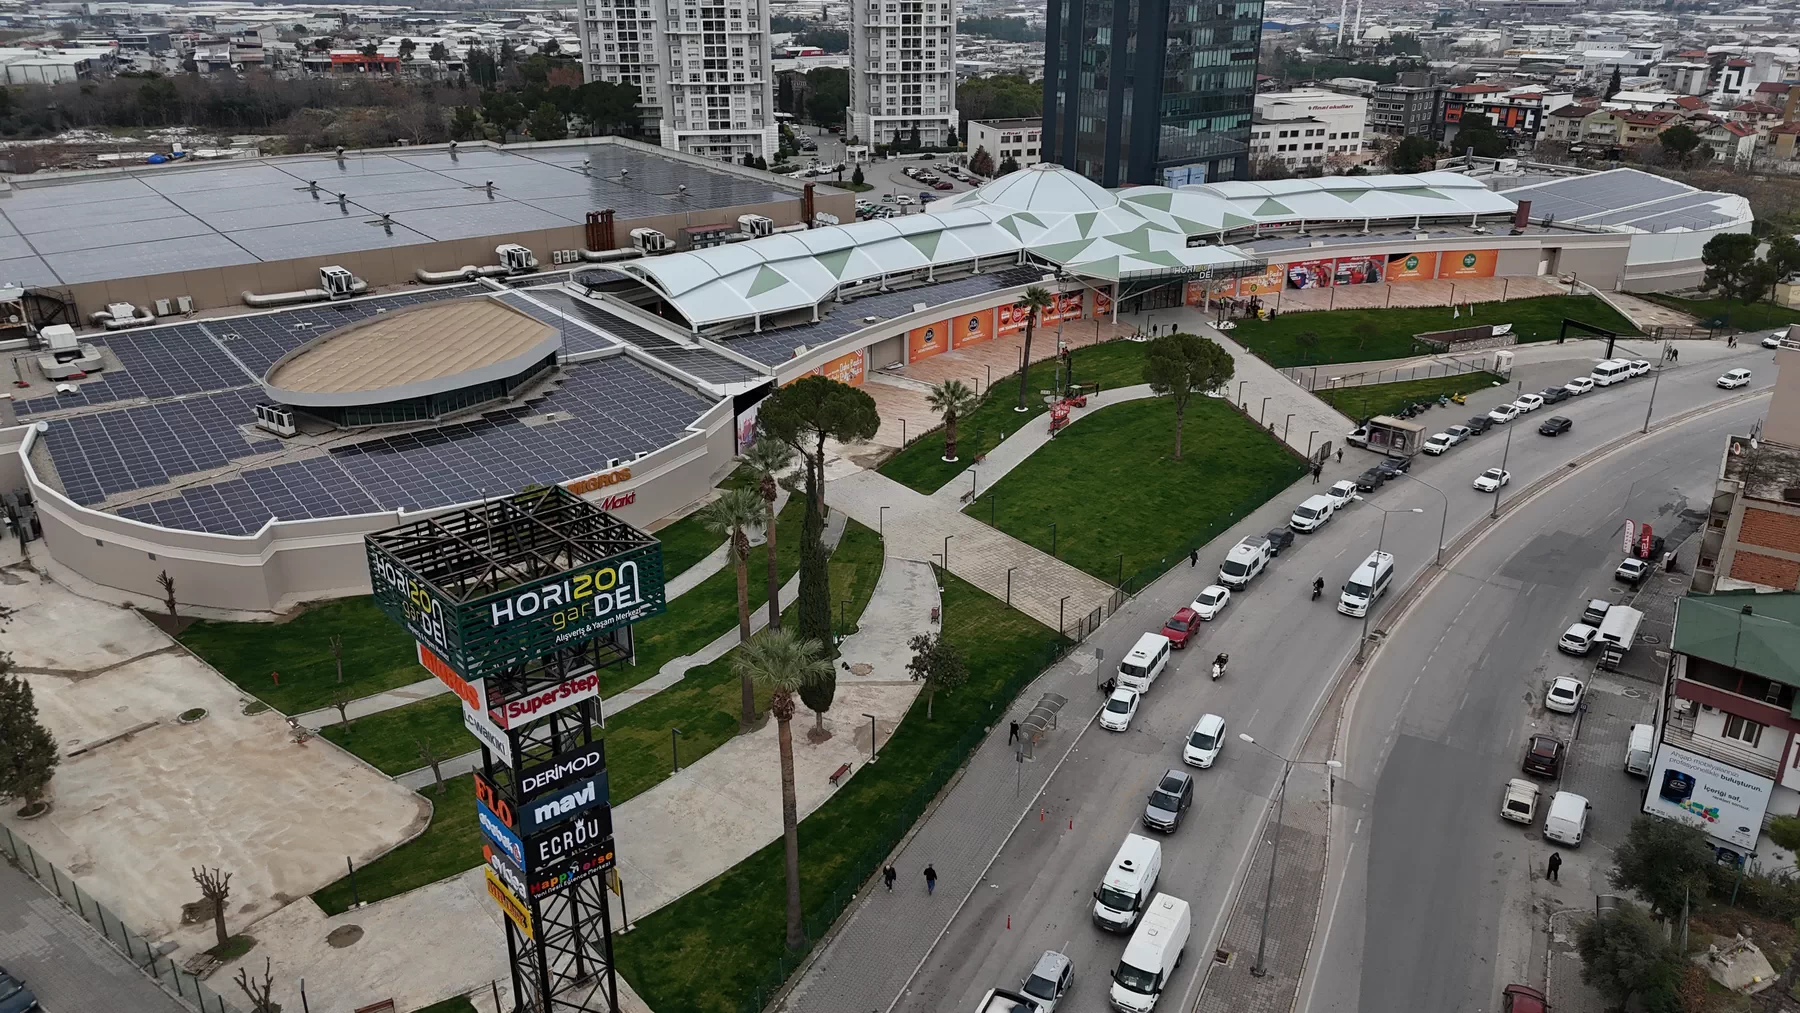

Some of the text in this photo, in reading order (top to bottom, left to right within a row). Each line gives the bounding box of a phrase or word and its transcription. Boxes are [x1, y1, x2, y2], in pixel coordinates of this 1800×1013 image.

[586, 624, 592, 632] &
[592, 616, 615, 630] Yaşam
[508, 674, 599, 718] SuperStep
[1720, 774, 1763, 792] buluşturun.
[473, 773, 513, 828] FLO
[534, 781, 596, 824] mavi
[530, 871, 574, 894] Happy
